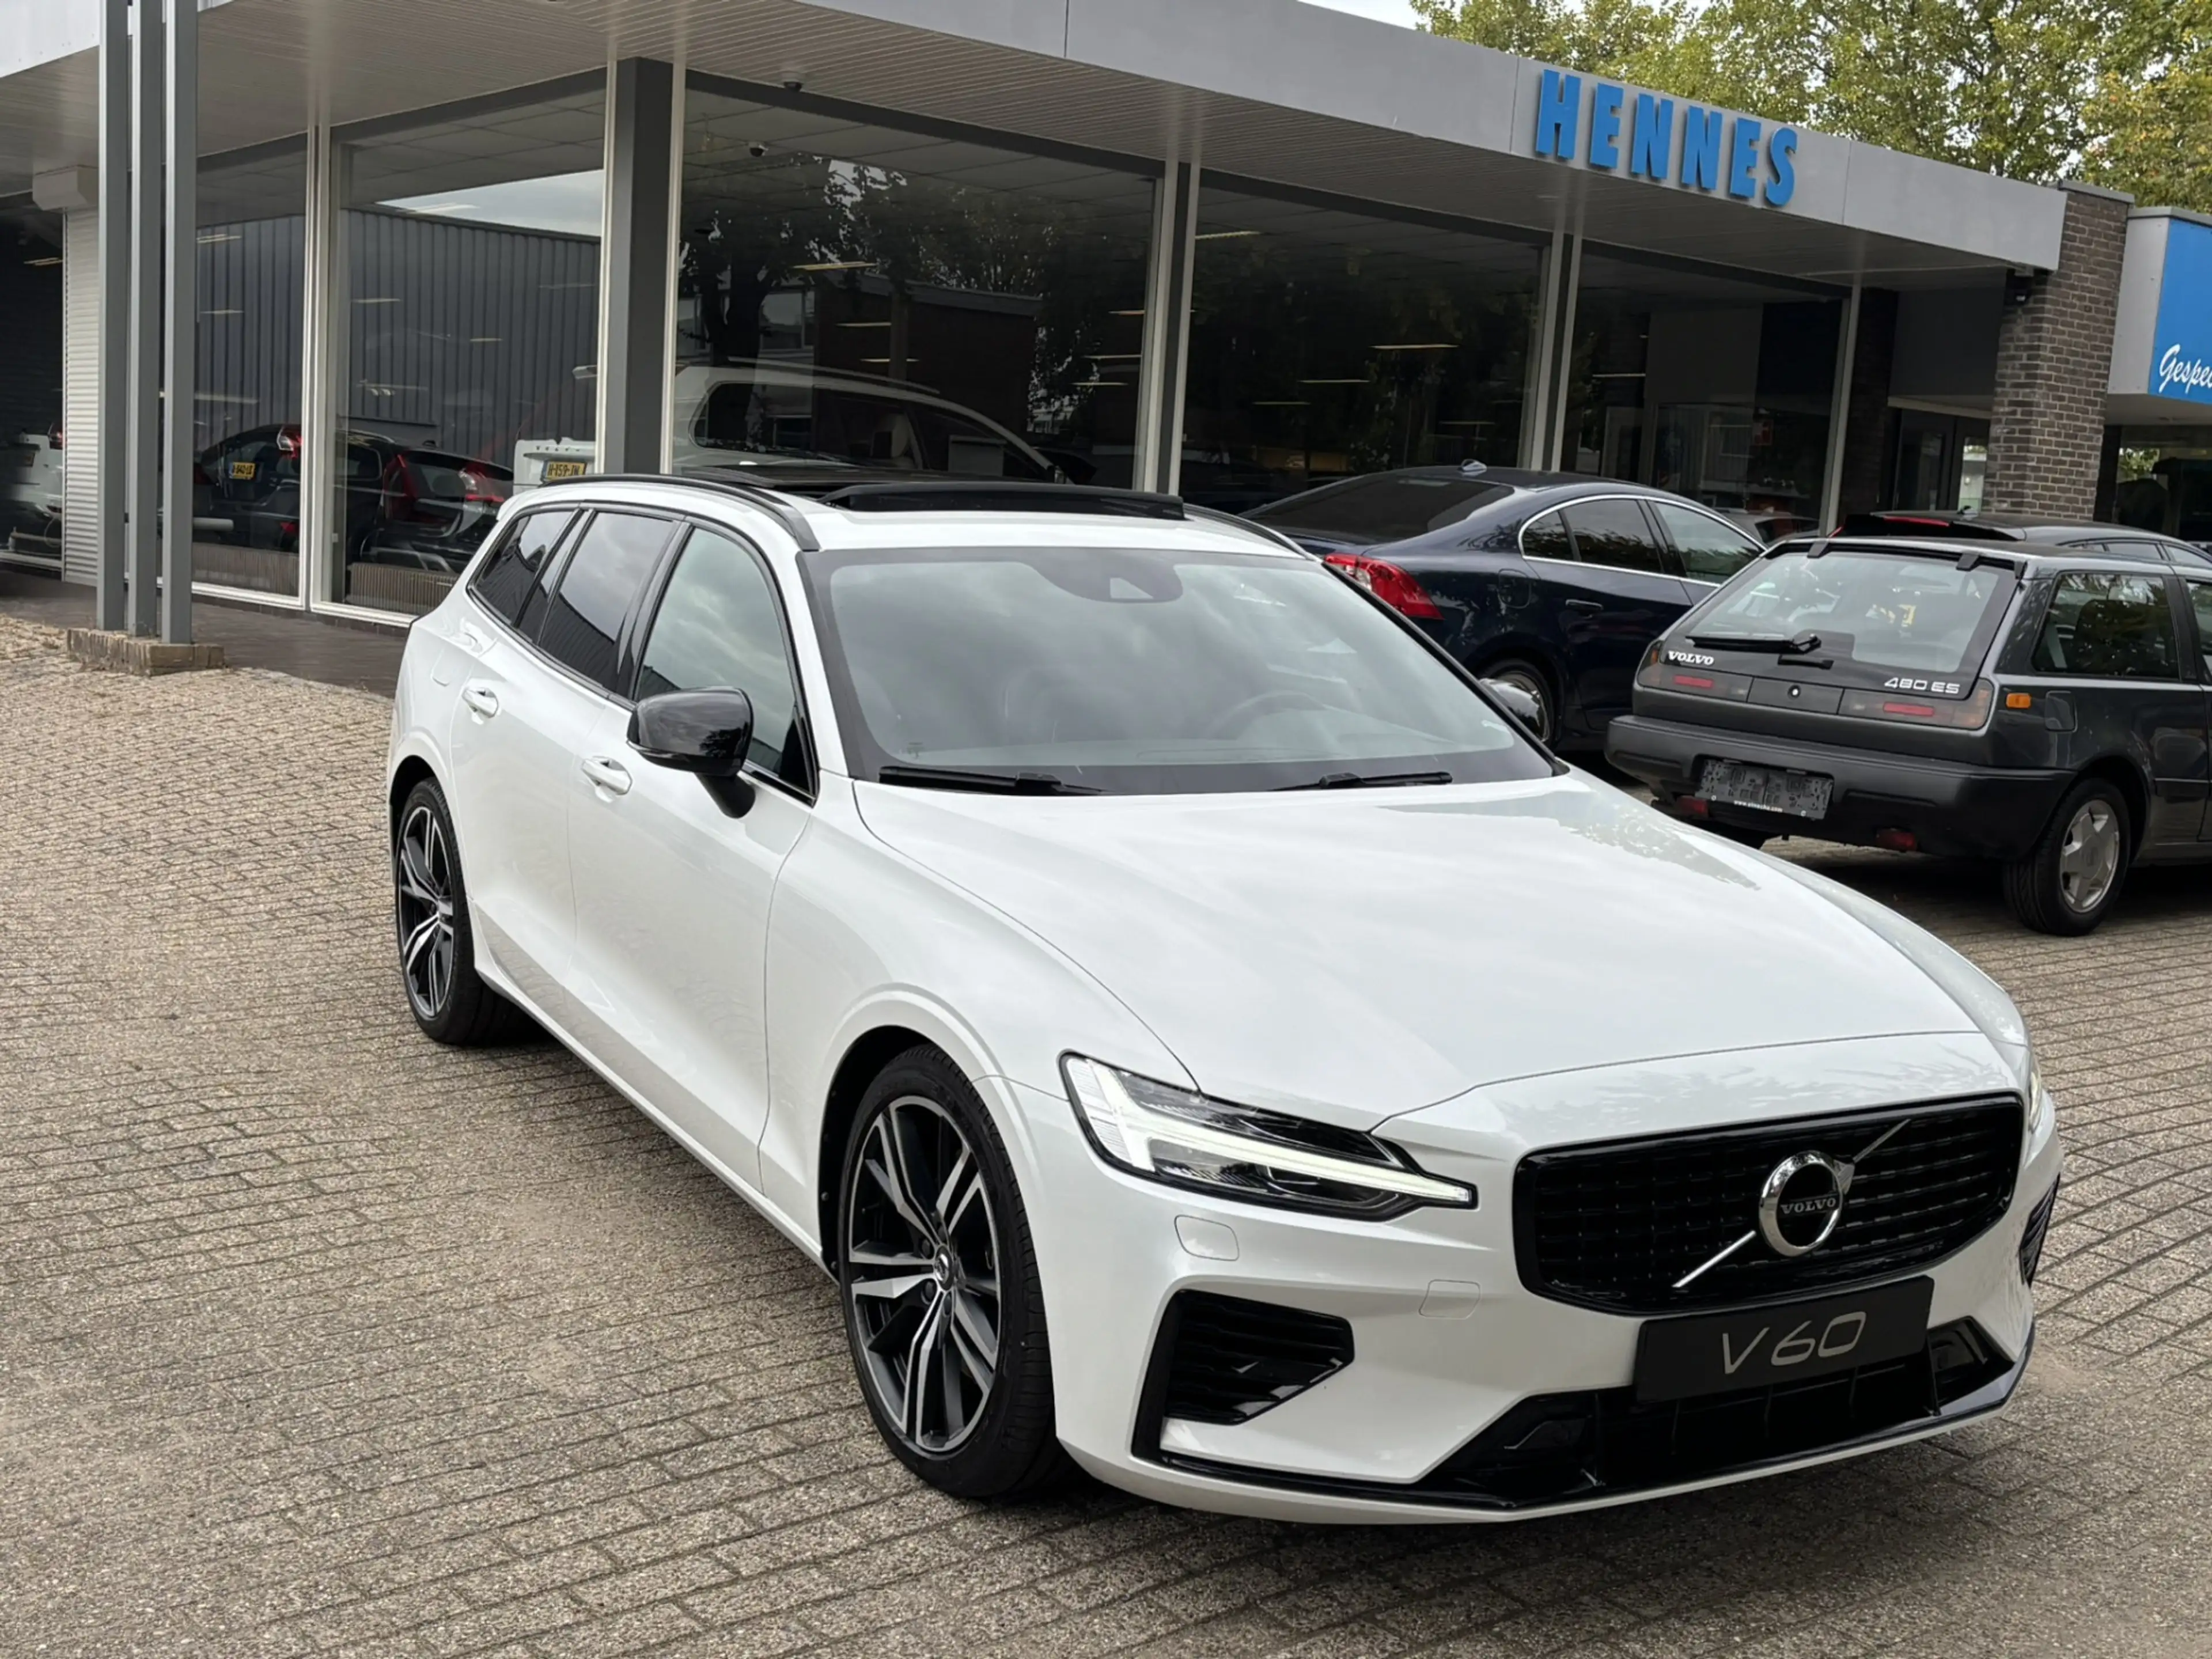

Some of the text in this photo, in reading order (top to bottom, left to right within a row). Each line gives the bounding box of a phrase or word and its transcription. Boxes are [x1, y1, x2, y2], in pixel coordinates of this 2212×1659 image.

[1536, 69, 1798, 207] HENNES
[1668, 651, 1714, 666] VOLVO
[1884, 677, 1960, 695] 480 ES
[1780, 1198, 1837, 1215] VOLVO
[1721, 1310, 1866, 1375] V60
